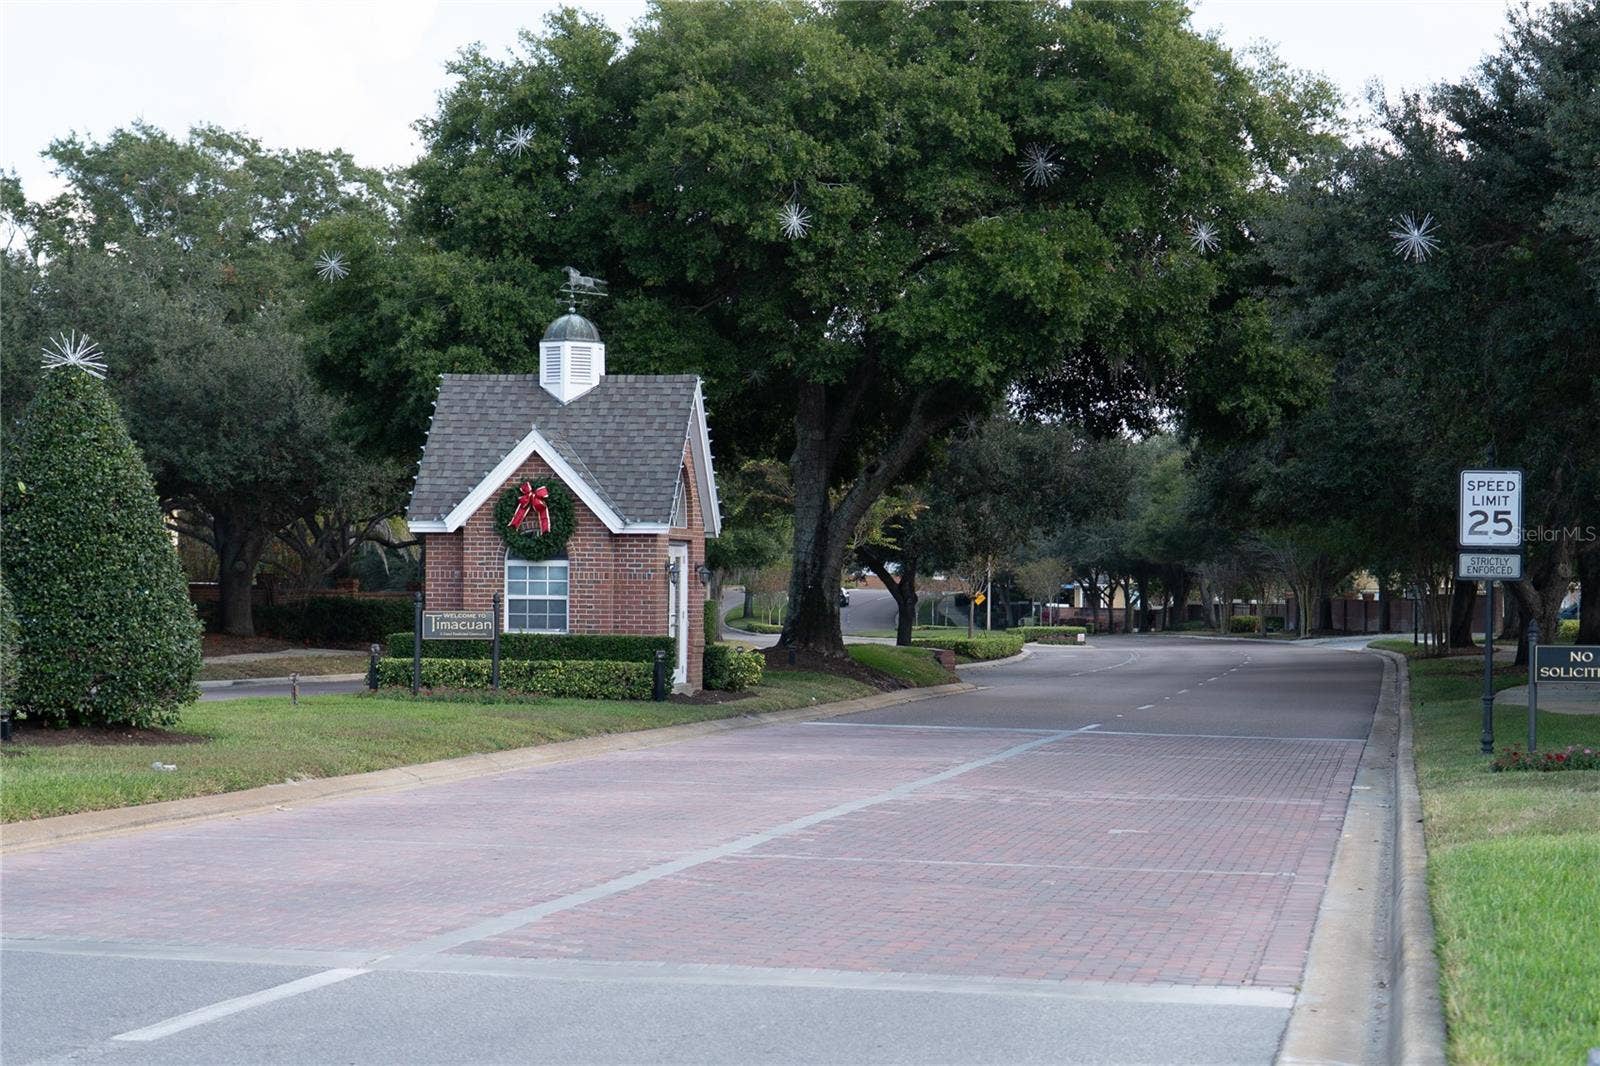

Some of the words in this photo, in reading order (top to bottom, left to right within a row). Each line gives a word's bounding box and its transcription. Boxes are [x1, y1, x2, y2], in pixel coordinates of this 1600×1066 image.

[1467, 480, 1515, 491] SPEED
[1472, 495, 1510, 506] LIMIT
[1468, 510, 1513, 536] 25
[1470, 558, 1510, 566] STRICTLY
[1466, 566, 1513, 575] ENFORCED
[425, 614, 492, 632] Timacuan
[1570, 651, 1593, 662] NO
